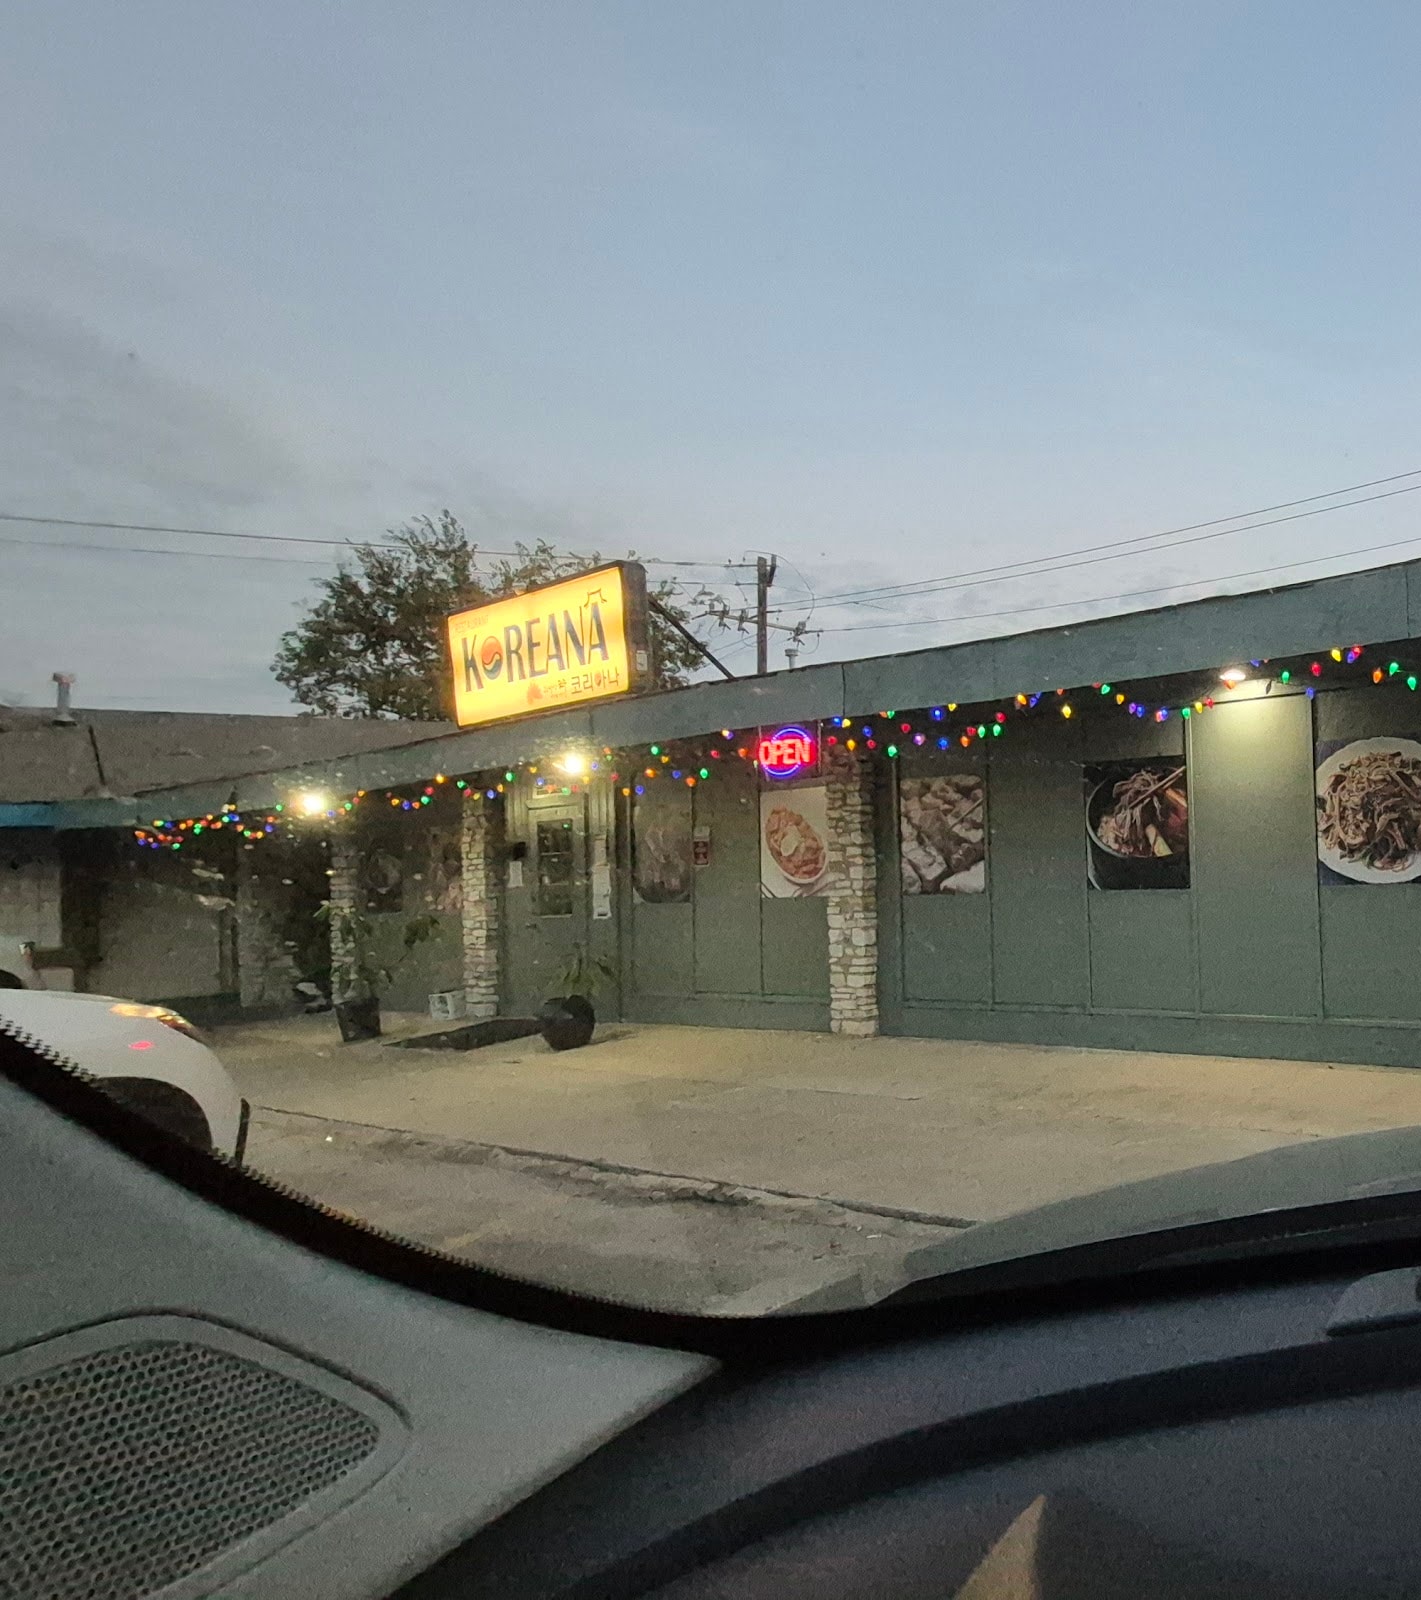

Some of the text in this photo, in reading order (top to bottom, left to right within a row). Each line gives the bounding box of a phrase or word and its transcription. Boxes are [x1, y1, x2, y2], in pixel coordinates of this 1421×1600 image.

[461, 600, 609, 692] KOREANA
[571, 666, 620, 695] 코리아나
[759, 738, 811, 765] OPEN
